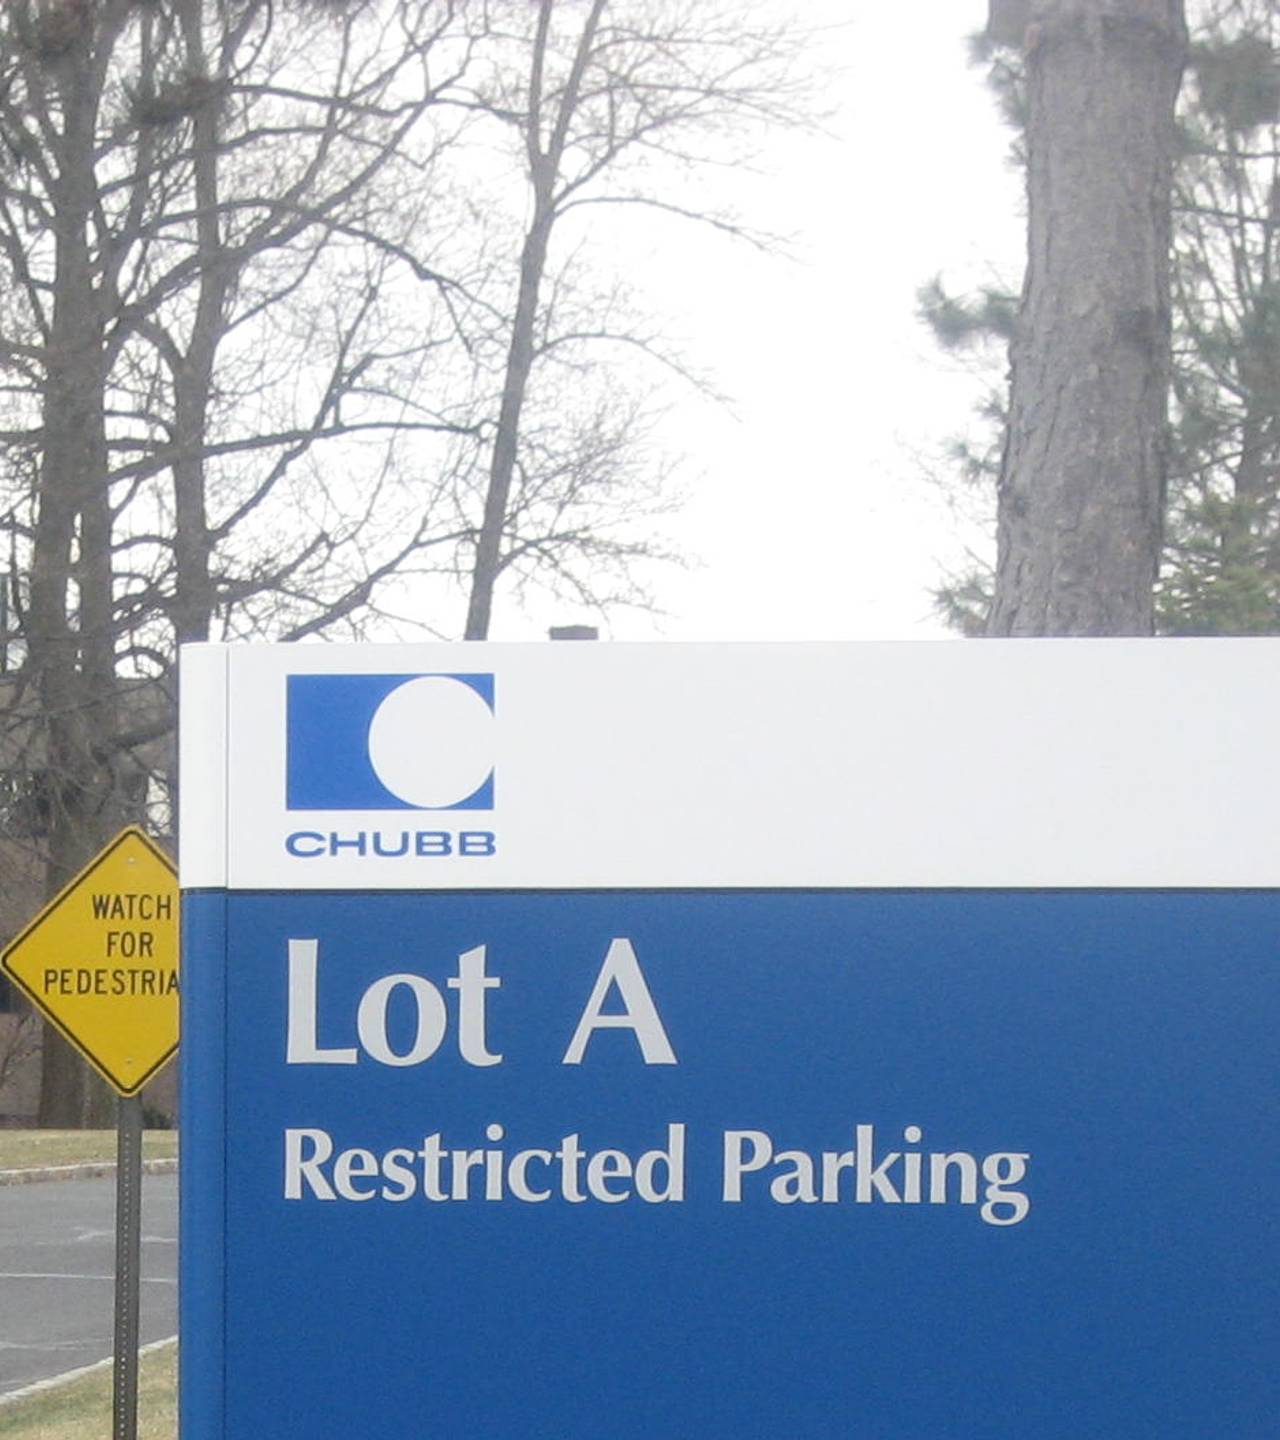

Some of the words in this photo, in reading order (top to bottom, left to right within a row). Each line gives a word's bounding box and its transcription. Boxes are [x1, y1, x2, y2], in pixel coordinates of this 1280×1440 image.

[285, 831, 496, 857] CHUBB
[92, 894, 171, 920] WATCH
[107, 932, 153, 957] FOR
[286, 938, 503, 1067] Lot
[562, 938, 678, 1065] A
[284, 1123, 686, 1203] Restricted
[722, 1124, 1030, 1226] Parking
